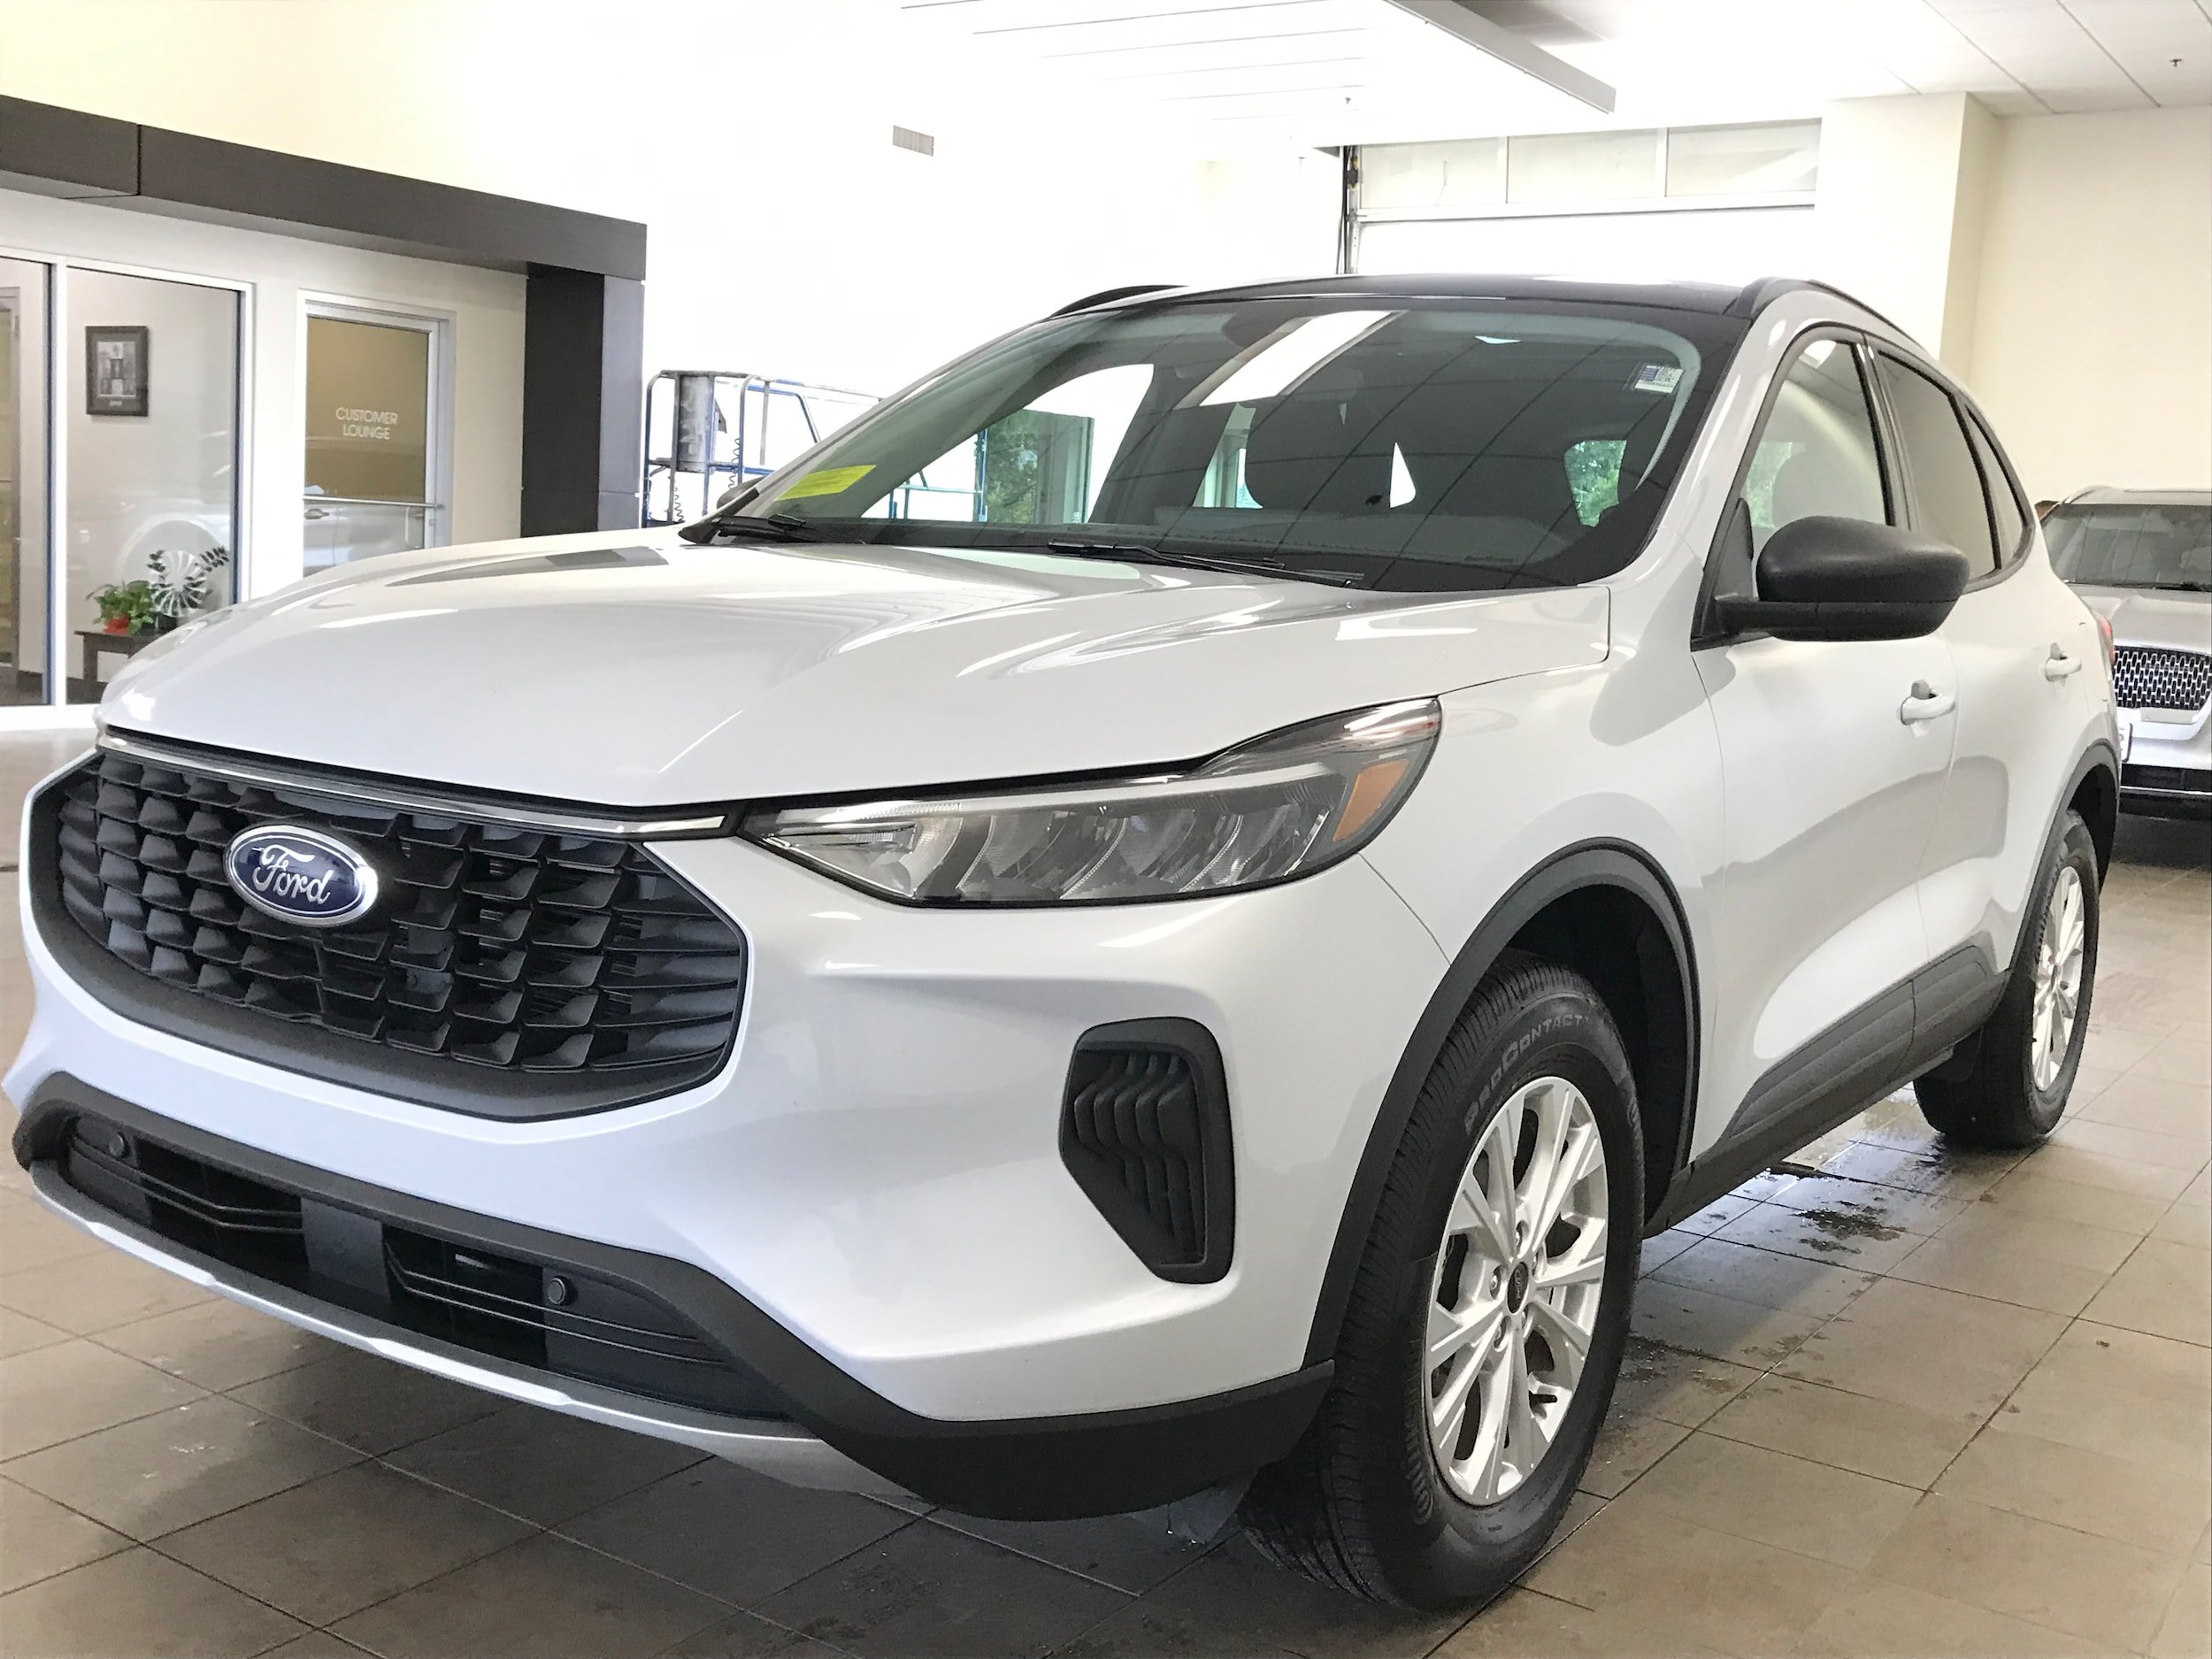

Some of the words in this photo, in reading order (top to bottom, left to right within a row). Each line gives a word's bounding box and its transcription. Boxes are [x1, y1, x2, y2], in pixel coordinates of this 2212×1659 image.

[335, 407, 398, 425] CUSTOMER
[342, 424, 390, 440] LOUNGE
[251, 844, 334, 904] Ford
